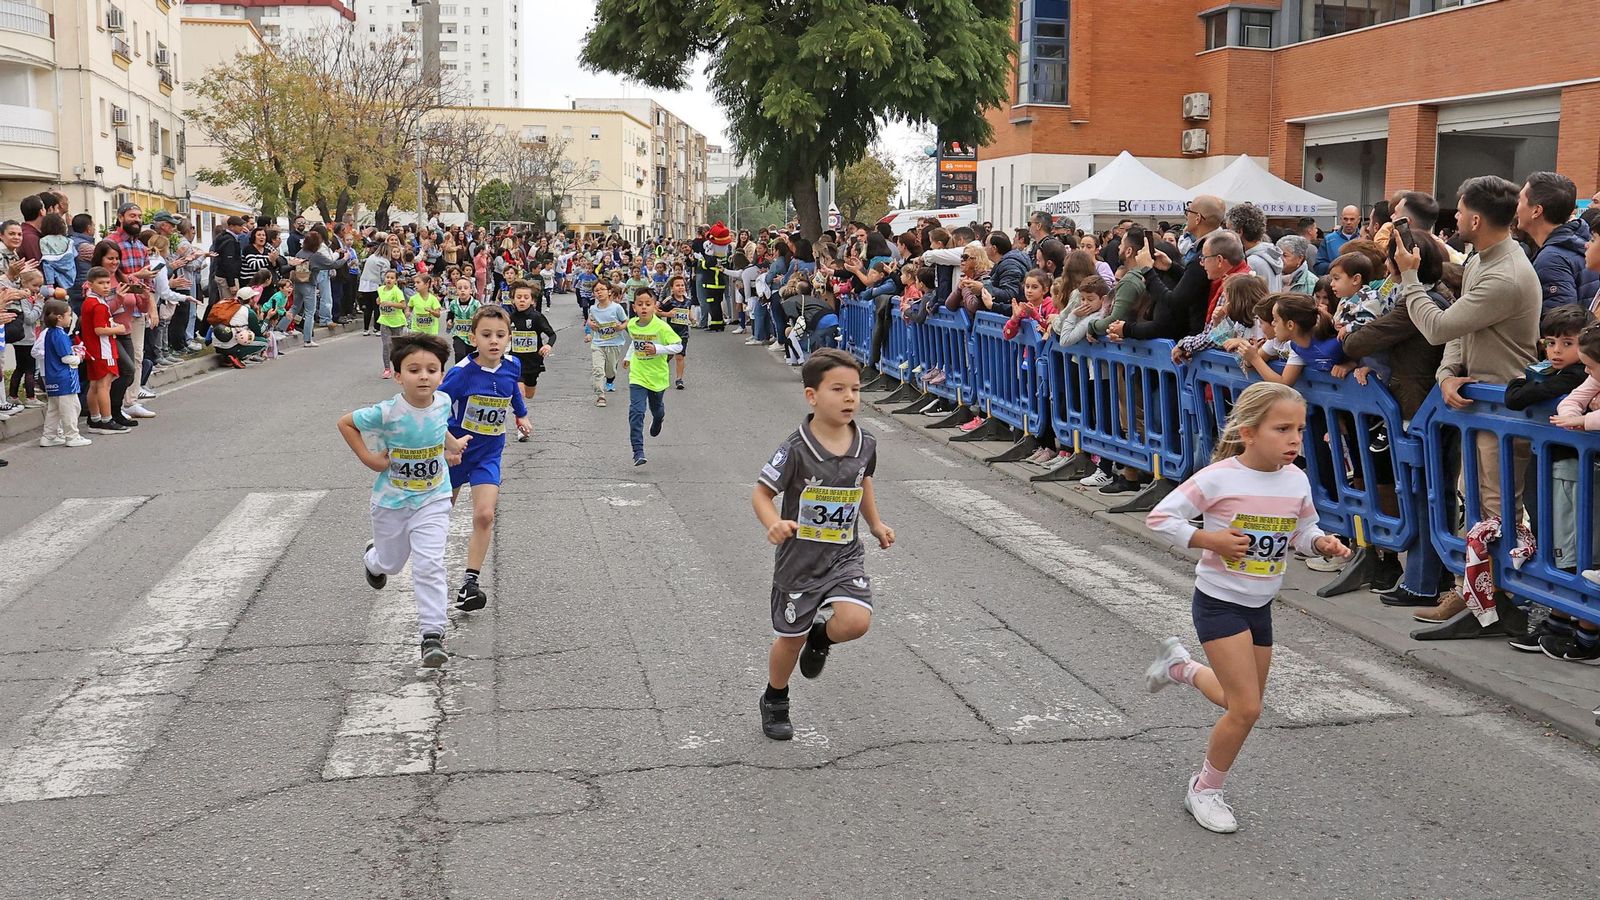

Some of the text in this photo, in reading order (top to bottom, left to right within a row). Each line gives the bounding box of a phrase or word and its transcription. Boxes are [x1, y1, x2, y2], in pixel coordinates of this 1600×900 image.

[1046, 201, 1080, 214] BOMBEROS
[476, 409, 506, 423] 103
[399, 460, 438, 477] 480
[806, 487, 828, 495] CARRERA
[830, 488, 849, 496] INFANTIL
[815, 495, 841, 503] BOMBEROS
[1259, 516, 1280, 524] INFANTIL
[1243, 522, 1272, 530] BOMBEROS
[1243, 533, 1288, 558] 292
